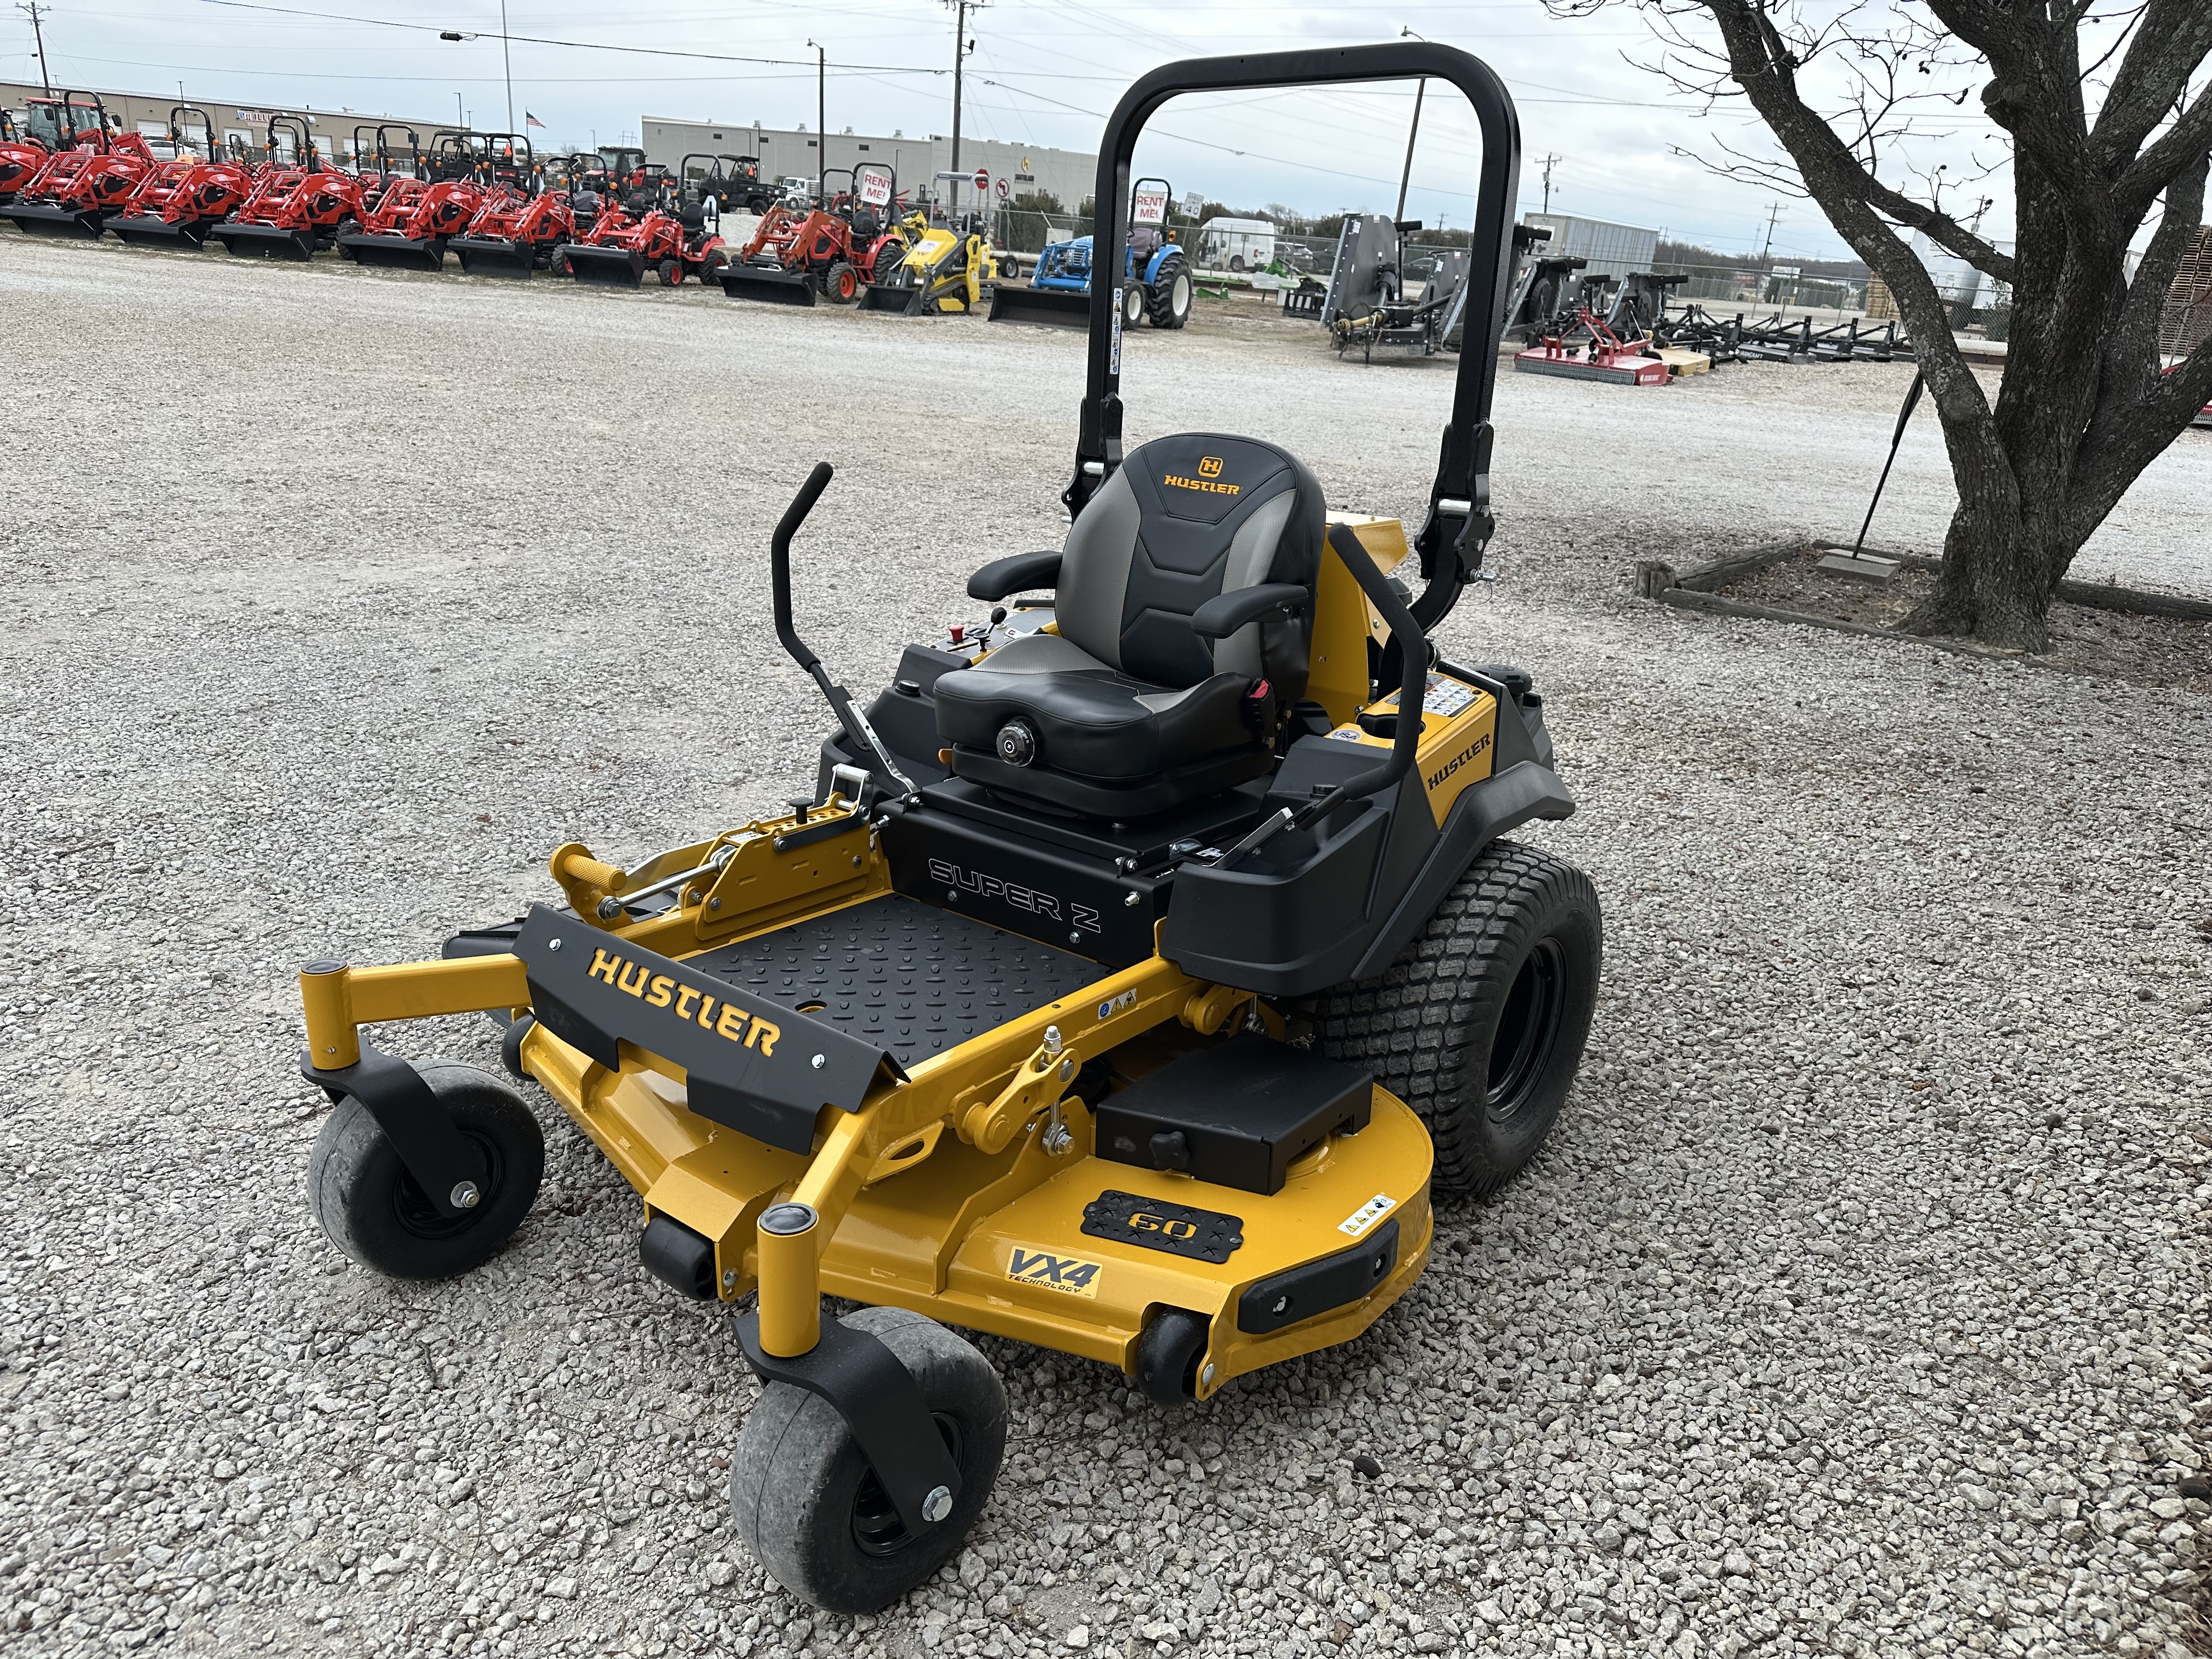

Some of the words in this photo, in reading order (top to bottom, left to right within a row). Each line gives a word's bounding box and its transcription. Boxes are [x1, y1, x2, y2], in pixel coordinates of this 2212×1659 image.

[865, 174, 891, 189] RENT
[867, 188, 885, 200] ME!
[1137, 196, 1163, 206] RENT
[1140, 208, 1158, 218] ME!
[1186, 206, 1199, 215] 40
[1164, 475, 1239, 495] HUSTLER
[1427, 733, 1491, 791] HUSTLER
[929, 858, 1063, 921] SUPER
[1071, 902, 1101, 934] Z
[585, 946, 781, 1058] HUSTLER
[1127, 1211, 1198, 1239] 60
[1010, 1249, 1101, 1288] VX4
[1008, 1274, 1081, 1293] TECHNOLOGY
